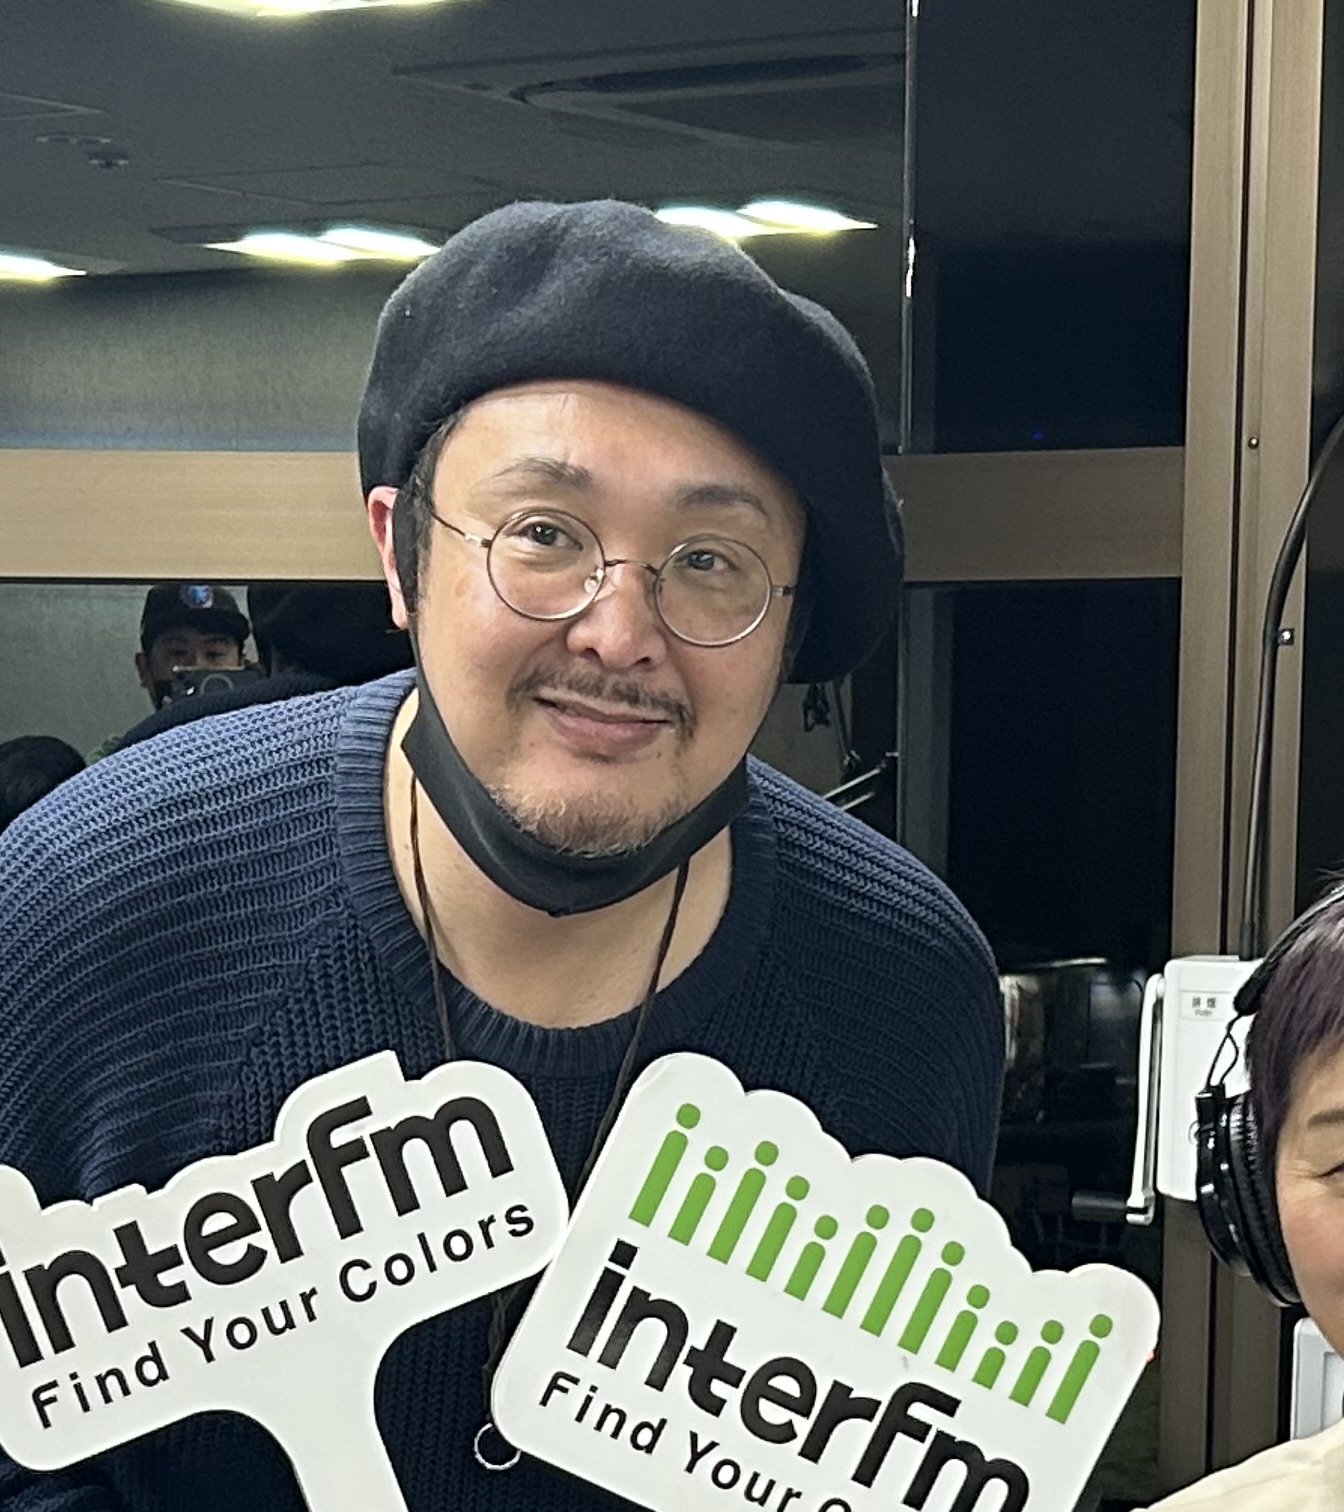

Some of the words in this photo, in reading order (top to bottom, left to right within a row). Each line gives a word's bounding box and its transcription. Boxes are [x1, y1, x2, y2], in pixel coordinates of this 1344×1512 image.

[32, 1341, 169, 1428] Find
[180, 1287, 318, 1363] Your
[339, 1204, 534, 1303] Colors
[540, 1372, 668, 1455] Find
